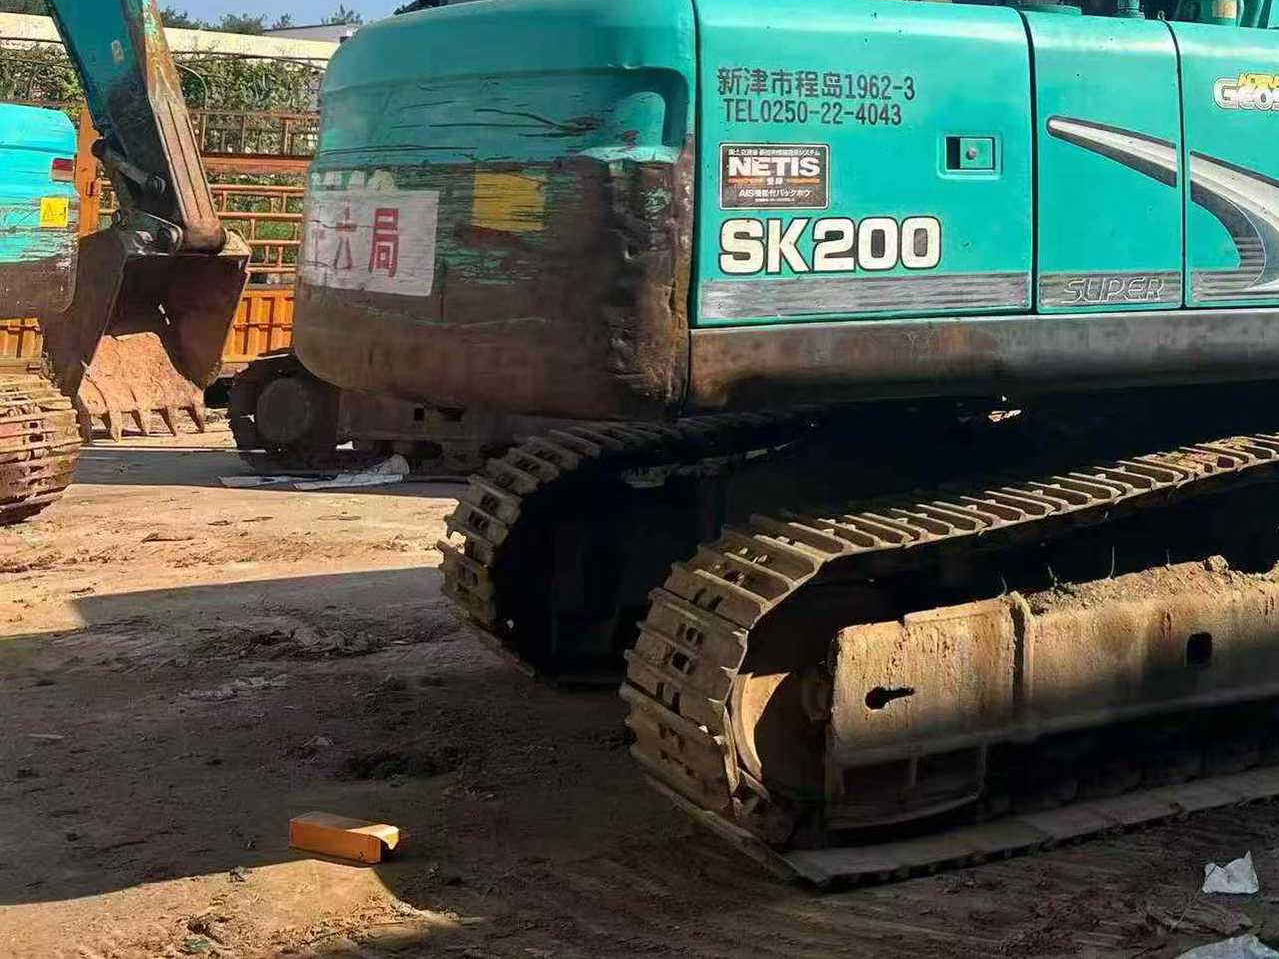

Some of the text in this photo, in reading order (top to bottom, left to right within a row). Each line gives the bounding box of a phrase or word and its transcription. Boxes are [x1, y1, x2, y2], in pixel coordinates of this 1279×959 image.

[728, 156, 821, 177] NETIS
[718, 216, 942, 275] SK200
[1061, 276, 1165, 305] SUPER
